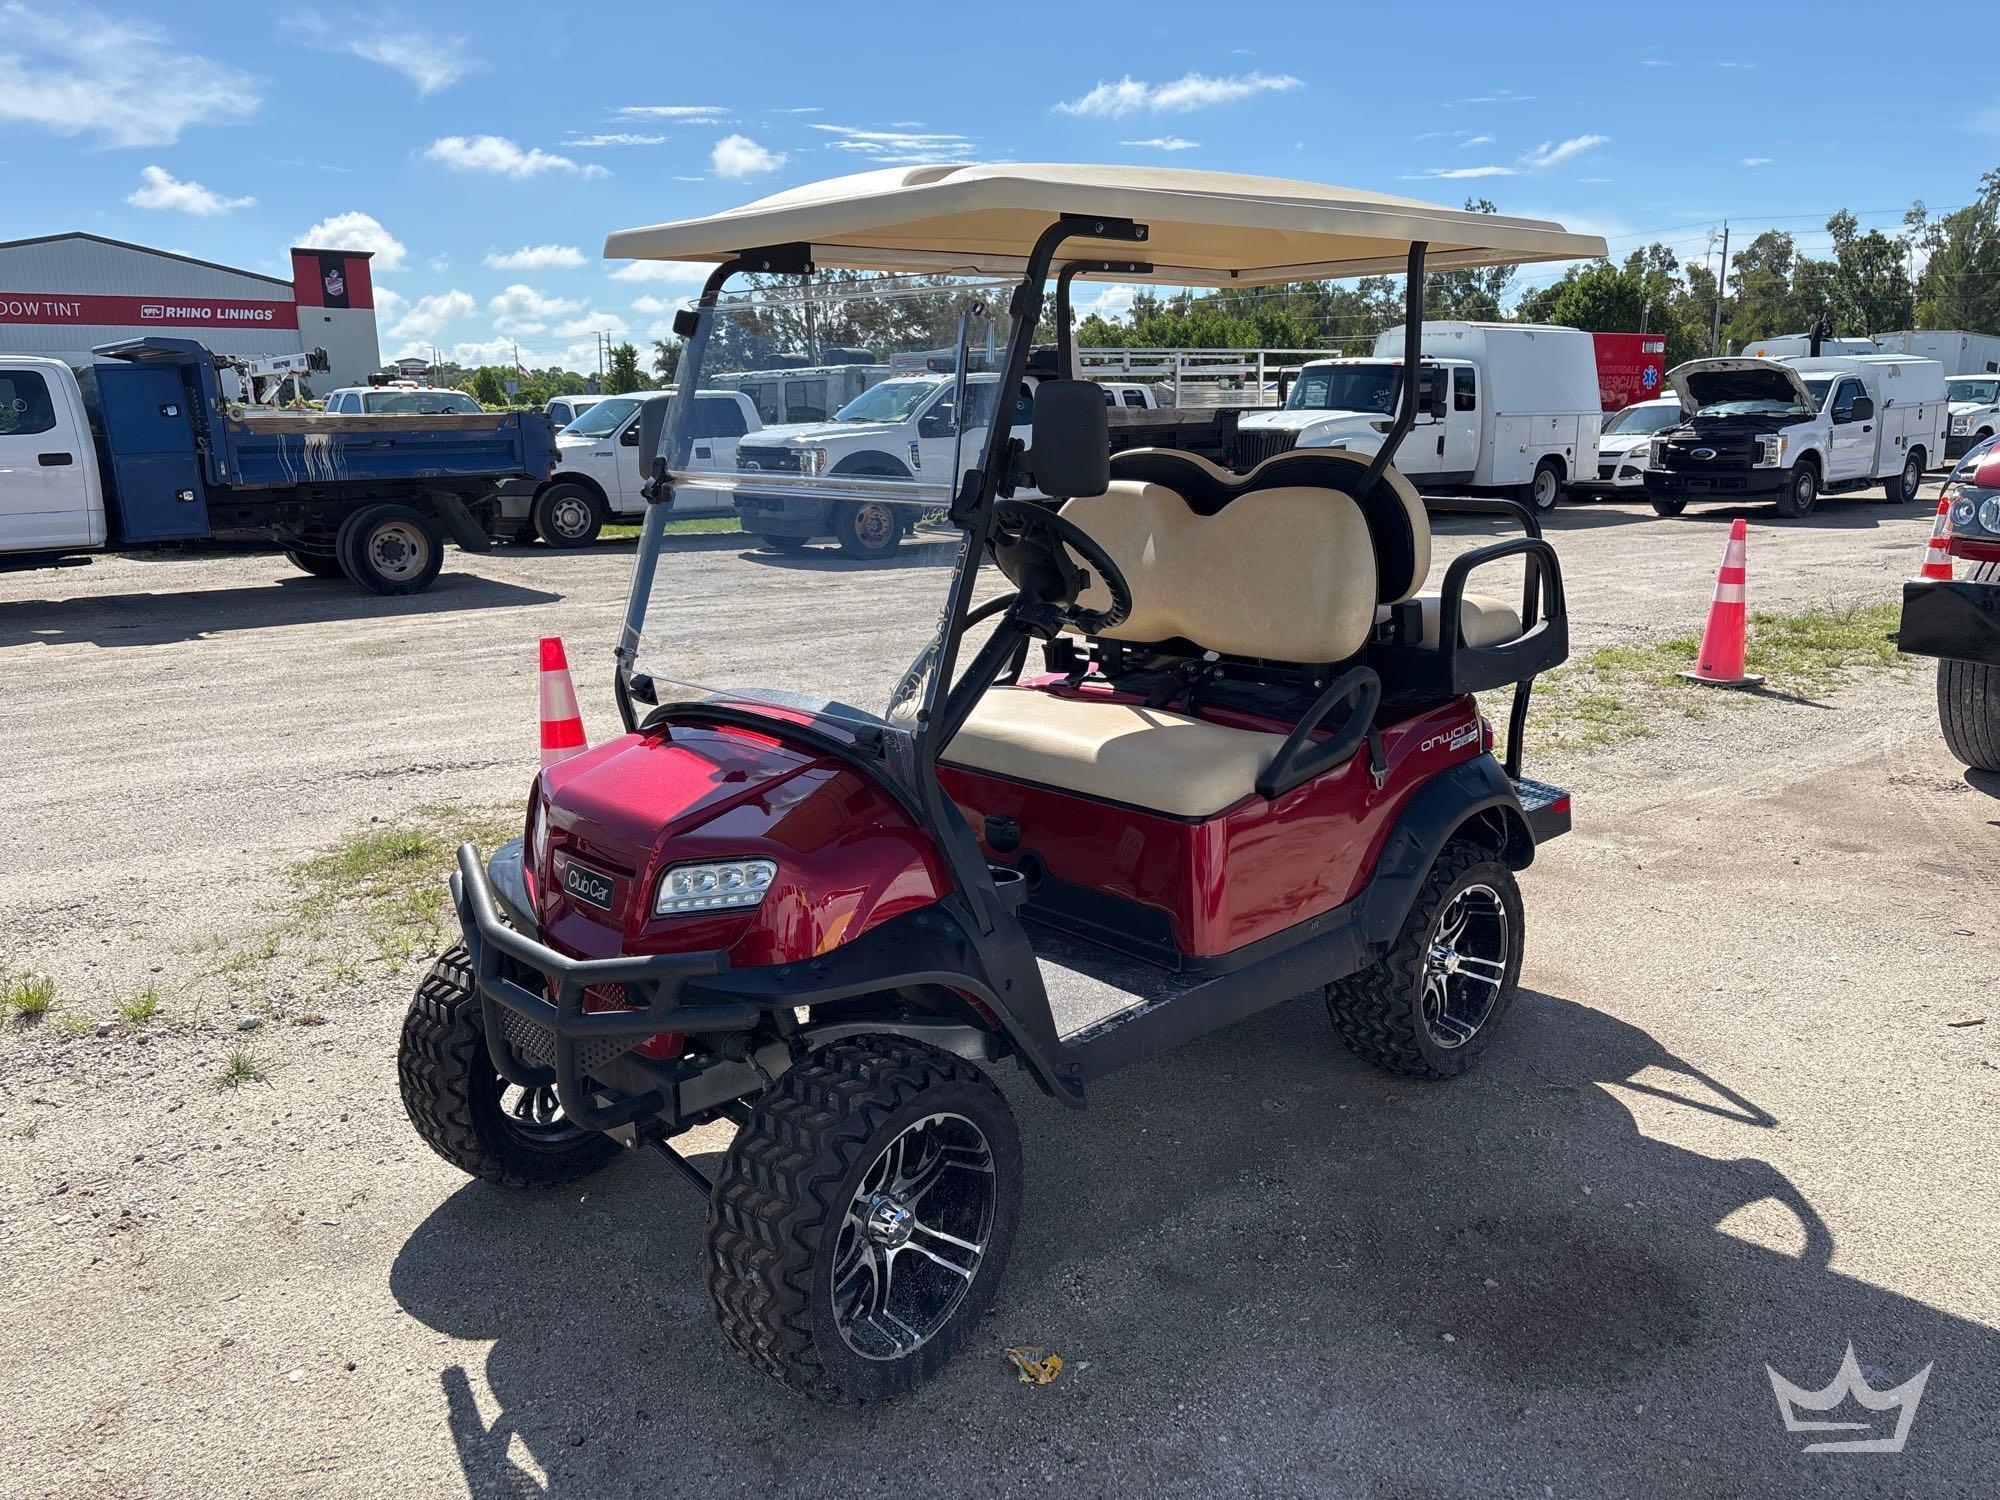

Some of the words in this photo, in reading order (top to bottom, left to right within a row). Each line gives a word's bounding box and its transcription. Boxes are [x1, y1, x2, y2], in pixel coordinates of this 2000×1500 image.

[43, 302, 81, 317] TINT
[166, 306, 212, 319] RHINO
[217, 308, 273, 321] LININGS
[569, 871, 589, 893] Club
[590, 880, 608, 900] Car
